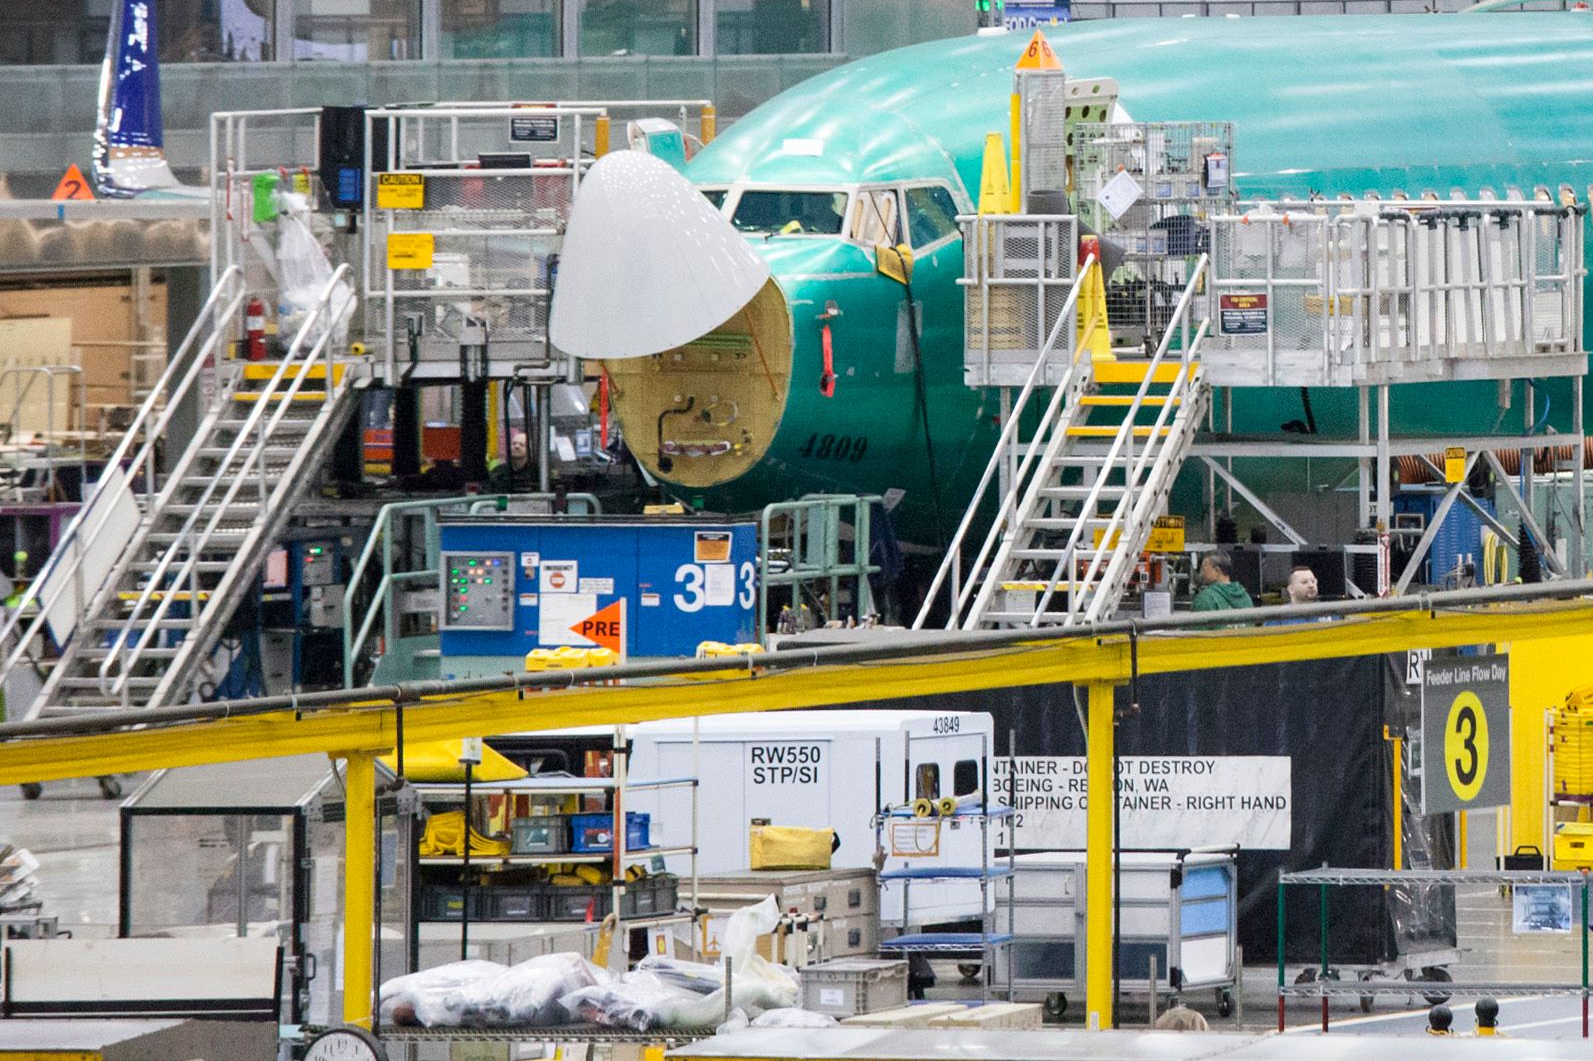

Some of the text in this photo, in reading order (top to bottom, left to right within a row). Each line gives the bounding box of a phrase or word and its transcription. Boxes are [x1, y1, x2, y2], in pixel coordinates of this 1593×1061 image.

[1028, 41, 1038, 57] 6
[64, 180, 81, 200] 2
[799, 433, 868, 461] 4809
[673, 564, 705, 613] 3
[739, 561, 755, 610] 3
[582, 621, 620, 637] PRE
[1427, 663, 1507, 685] Feeder Line Flow Day
[933, 716, 960, 734] 43849
[751, 746, 821, 764] RW550
[1455, 706, 1478, 786] 3
[753, 766, 818, 784] STP/SI
[1139, 760, 1215, 774] DESTROY
[1144, 778, 1170, 792] WA
[1187, 796, 1235, 810] RIGHT
[1241, 796, 1287, 810] HAND
